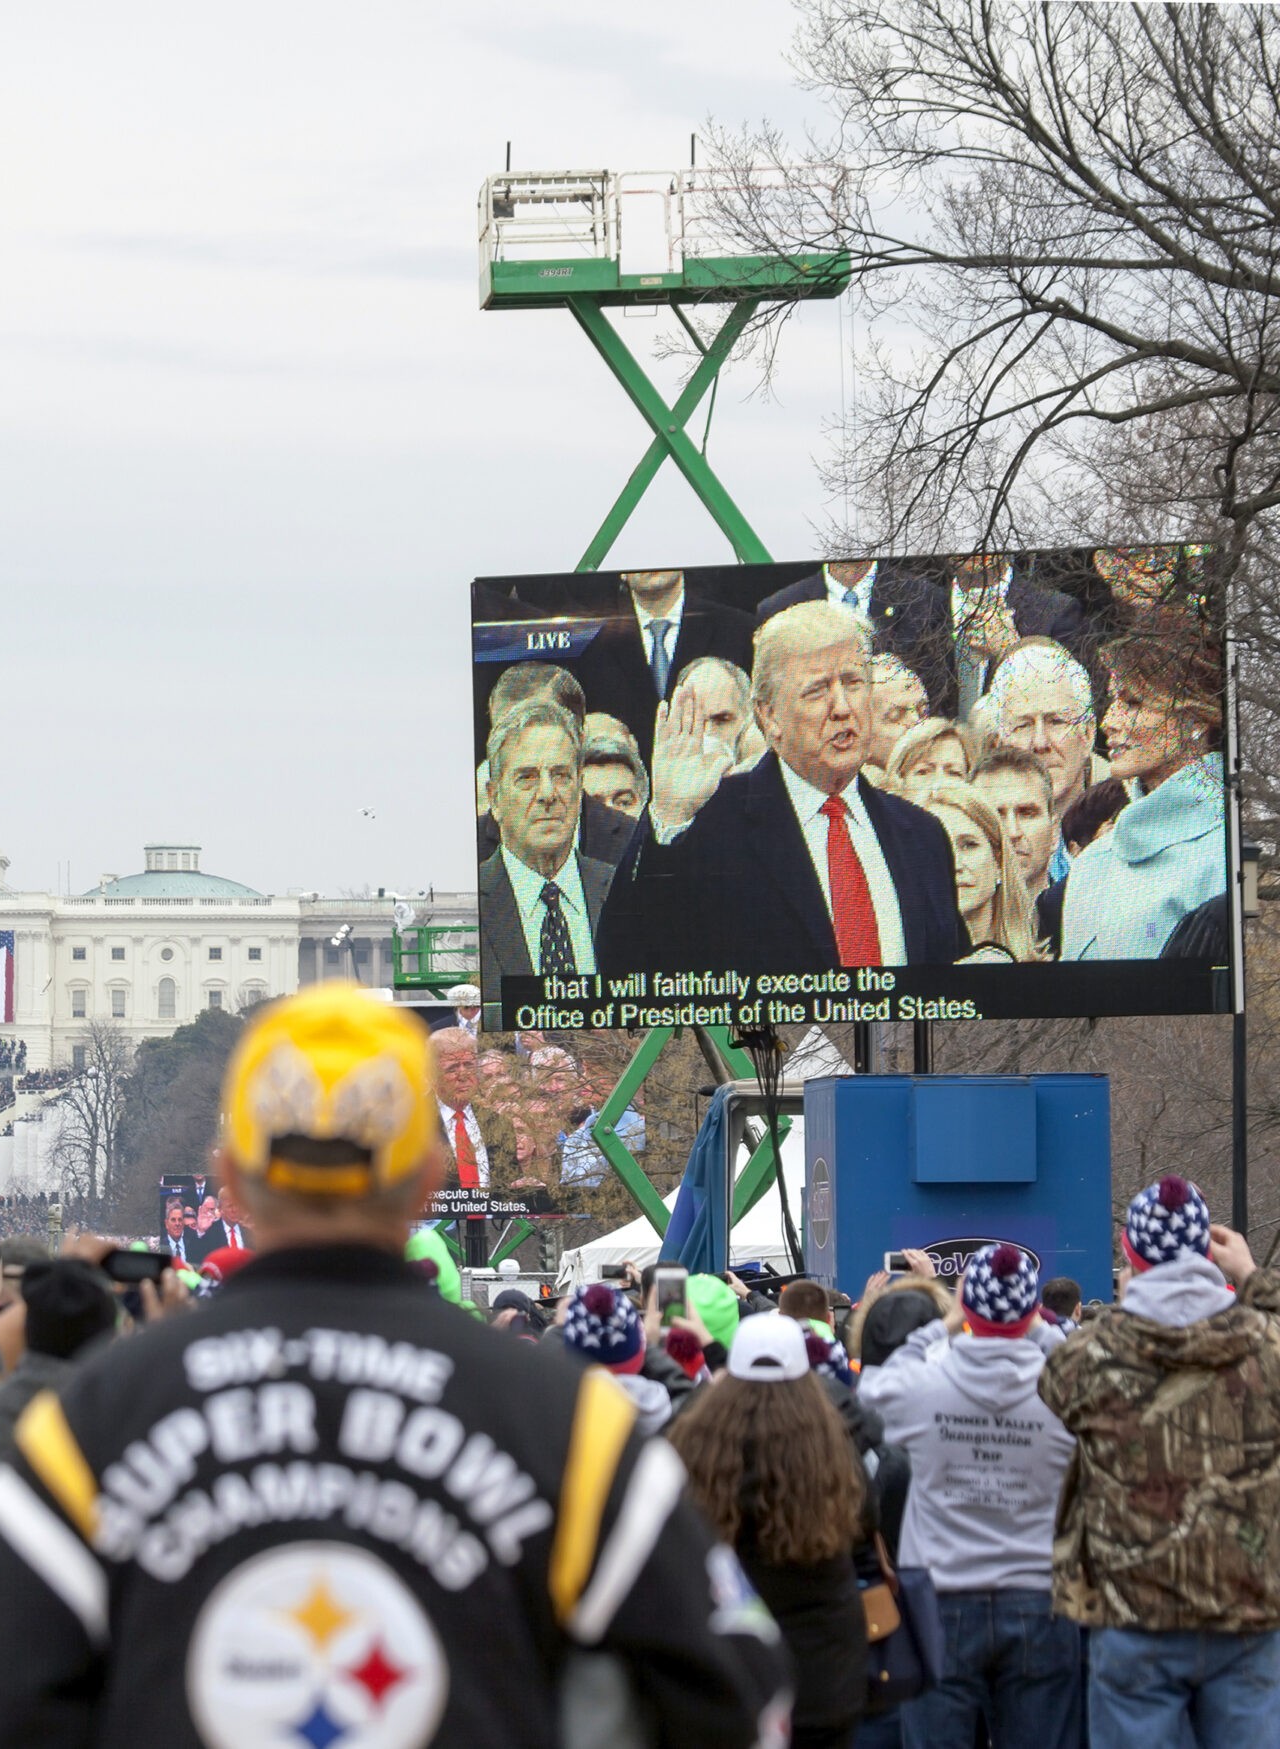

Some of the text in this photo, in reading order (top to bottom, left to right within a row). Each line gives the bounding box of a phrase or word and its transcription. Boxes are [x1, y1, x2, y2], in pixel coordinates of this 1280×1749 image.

[527, 631, 571, 650] LIVE
[544, 967, 896, 1000] that I will faithfully execute the
[516, 995, 983, 1029] Office of President of the United States,
[431, 1202, 448, 1212] the
[451, 1201, 487, 1212] United
[490, 1201, 530, 1213] States,
[472, 1189, 490, 1199] the
[184, 1326, 455, 1404] SIX-TIME
[993, 1415, 1045, 1432] VALLEY
[93, 1381, 554, 1567] SUPER BOWL
[138, 1460, 489, 1592] CHAMPIONS
